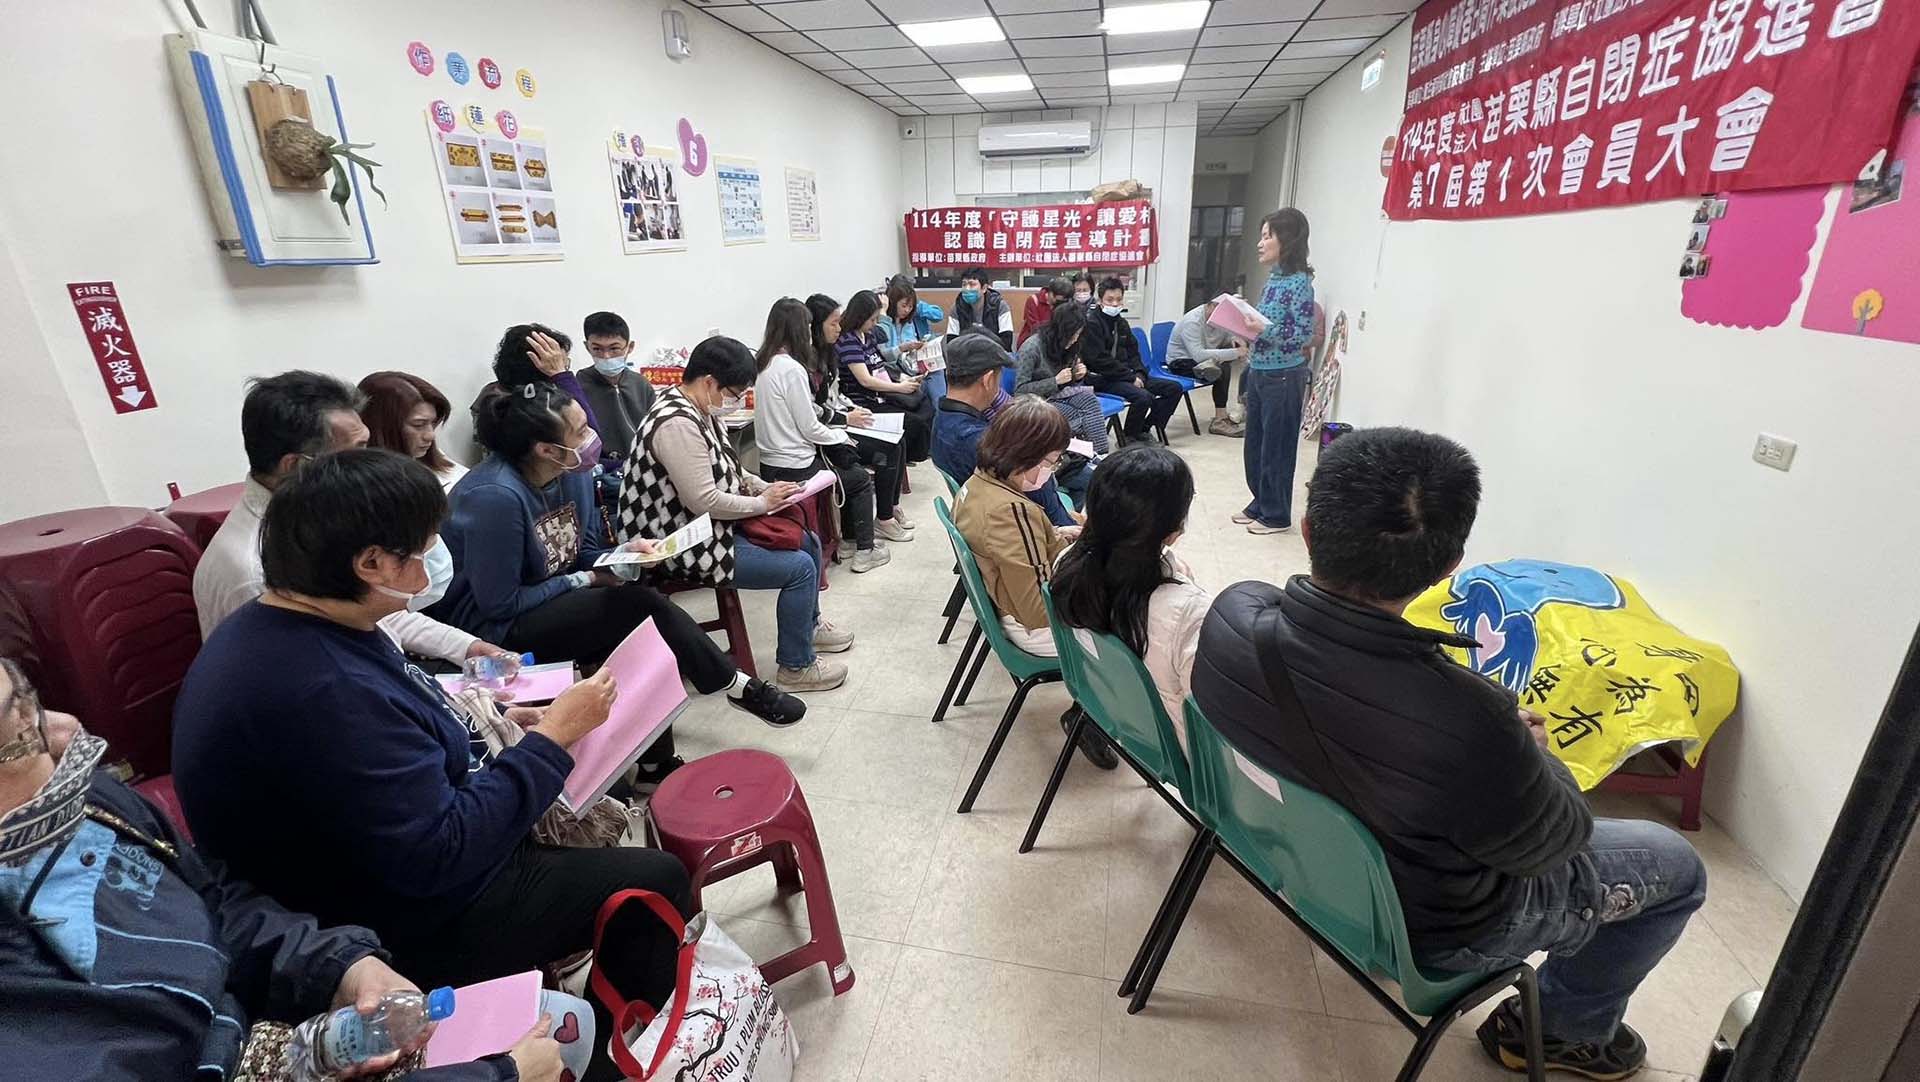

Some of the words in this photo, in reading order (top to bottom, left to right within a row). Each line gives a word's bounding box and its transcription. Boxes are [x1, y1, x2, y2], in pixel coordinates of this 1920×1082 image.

[690, 141, 699, 166] 6
[1407, 87, 1773, 209] 第7屆第1次會員大會
[75, 286, 112, 297] FIRE
[88, 306, 137, 384] 滅火器
